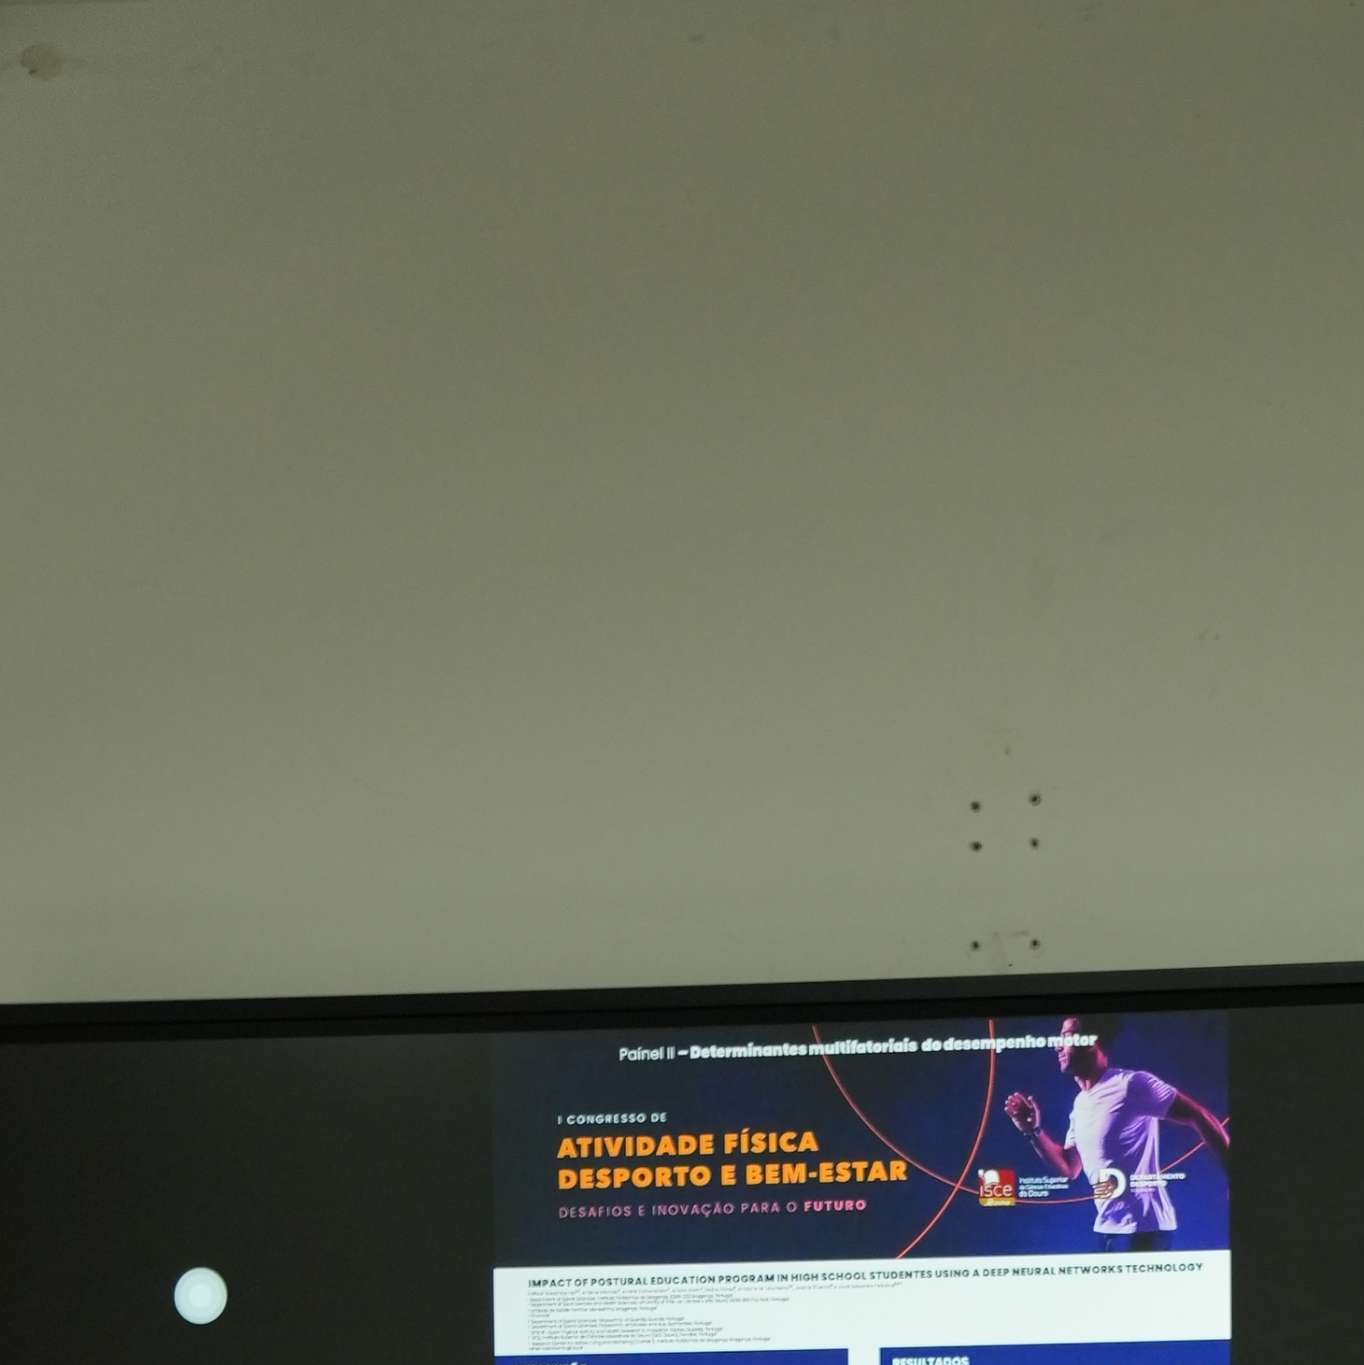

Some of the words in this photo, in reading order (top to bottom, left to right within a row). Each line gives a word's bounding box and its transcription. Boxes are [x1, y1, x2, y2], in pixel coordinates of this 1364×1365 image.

[619, 1046, 664, 1061] Painel
[689, 1041, 807, 1058] Determinantes
[808, 1037, 918, 1055] multifatoriais
[920, 1037, 942, 1051] do
[942, 1034, 1046, 1053] desempenho
[1047, 1032, 1097, 1050] motor
[557, 1115, 562, 1124] I
[566, 1112, 647, 1124] CONGRESSO
[650, 1112, 667, 1122] DE
[556, 1133, 714, 1159] ATIVIDADE
[723, 1126, 819, 1154] FÍSICA
[558, 1165, 712, 1189] DESPORTO
[720, 1164, 737, 1185] E
[745, 1159, 909, 1184] BEM-ESTAR
[558, 1205, 632, 1218] DESAFIOS
[635, 1204, 646, 1216] E
[651, 1202, 736, 1216] INOVAÇÃO
[740, 1201, 781, 1213] PARA
[785, 1201, 799, 1212] O
[803, 1199, 867, 1211] FUTURO
[528, 1278, 572, 1287] IMPACT
[573, 1278, 588, 1286] OF
[589, 1277, 648, 1286] POSTURAL
[650, 1275, 716, 1285] EDUCATION
[717, 1274, 775, 1283] PROGRAM
[790, 1273, 819, 1281] HIGH
[820, 1271, 866, 1281] SCHOOL
[868, 1270, 932, 1279] STUDENTES
[934, 1269, 970, 1278] USING
[982, 1267, 1010, 1277] DEEP
[1011, 1267, 1056, 1276] NEURAL
[1057, 1265, 1123, 1274] NETWORKS
[1124, 1262, 1203, 1272] TECHNOLOGY
